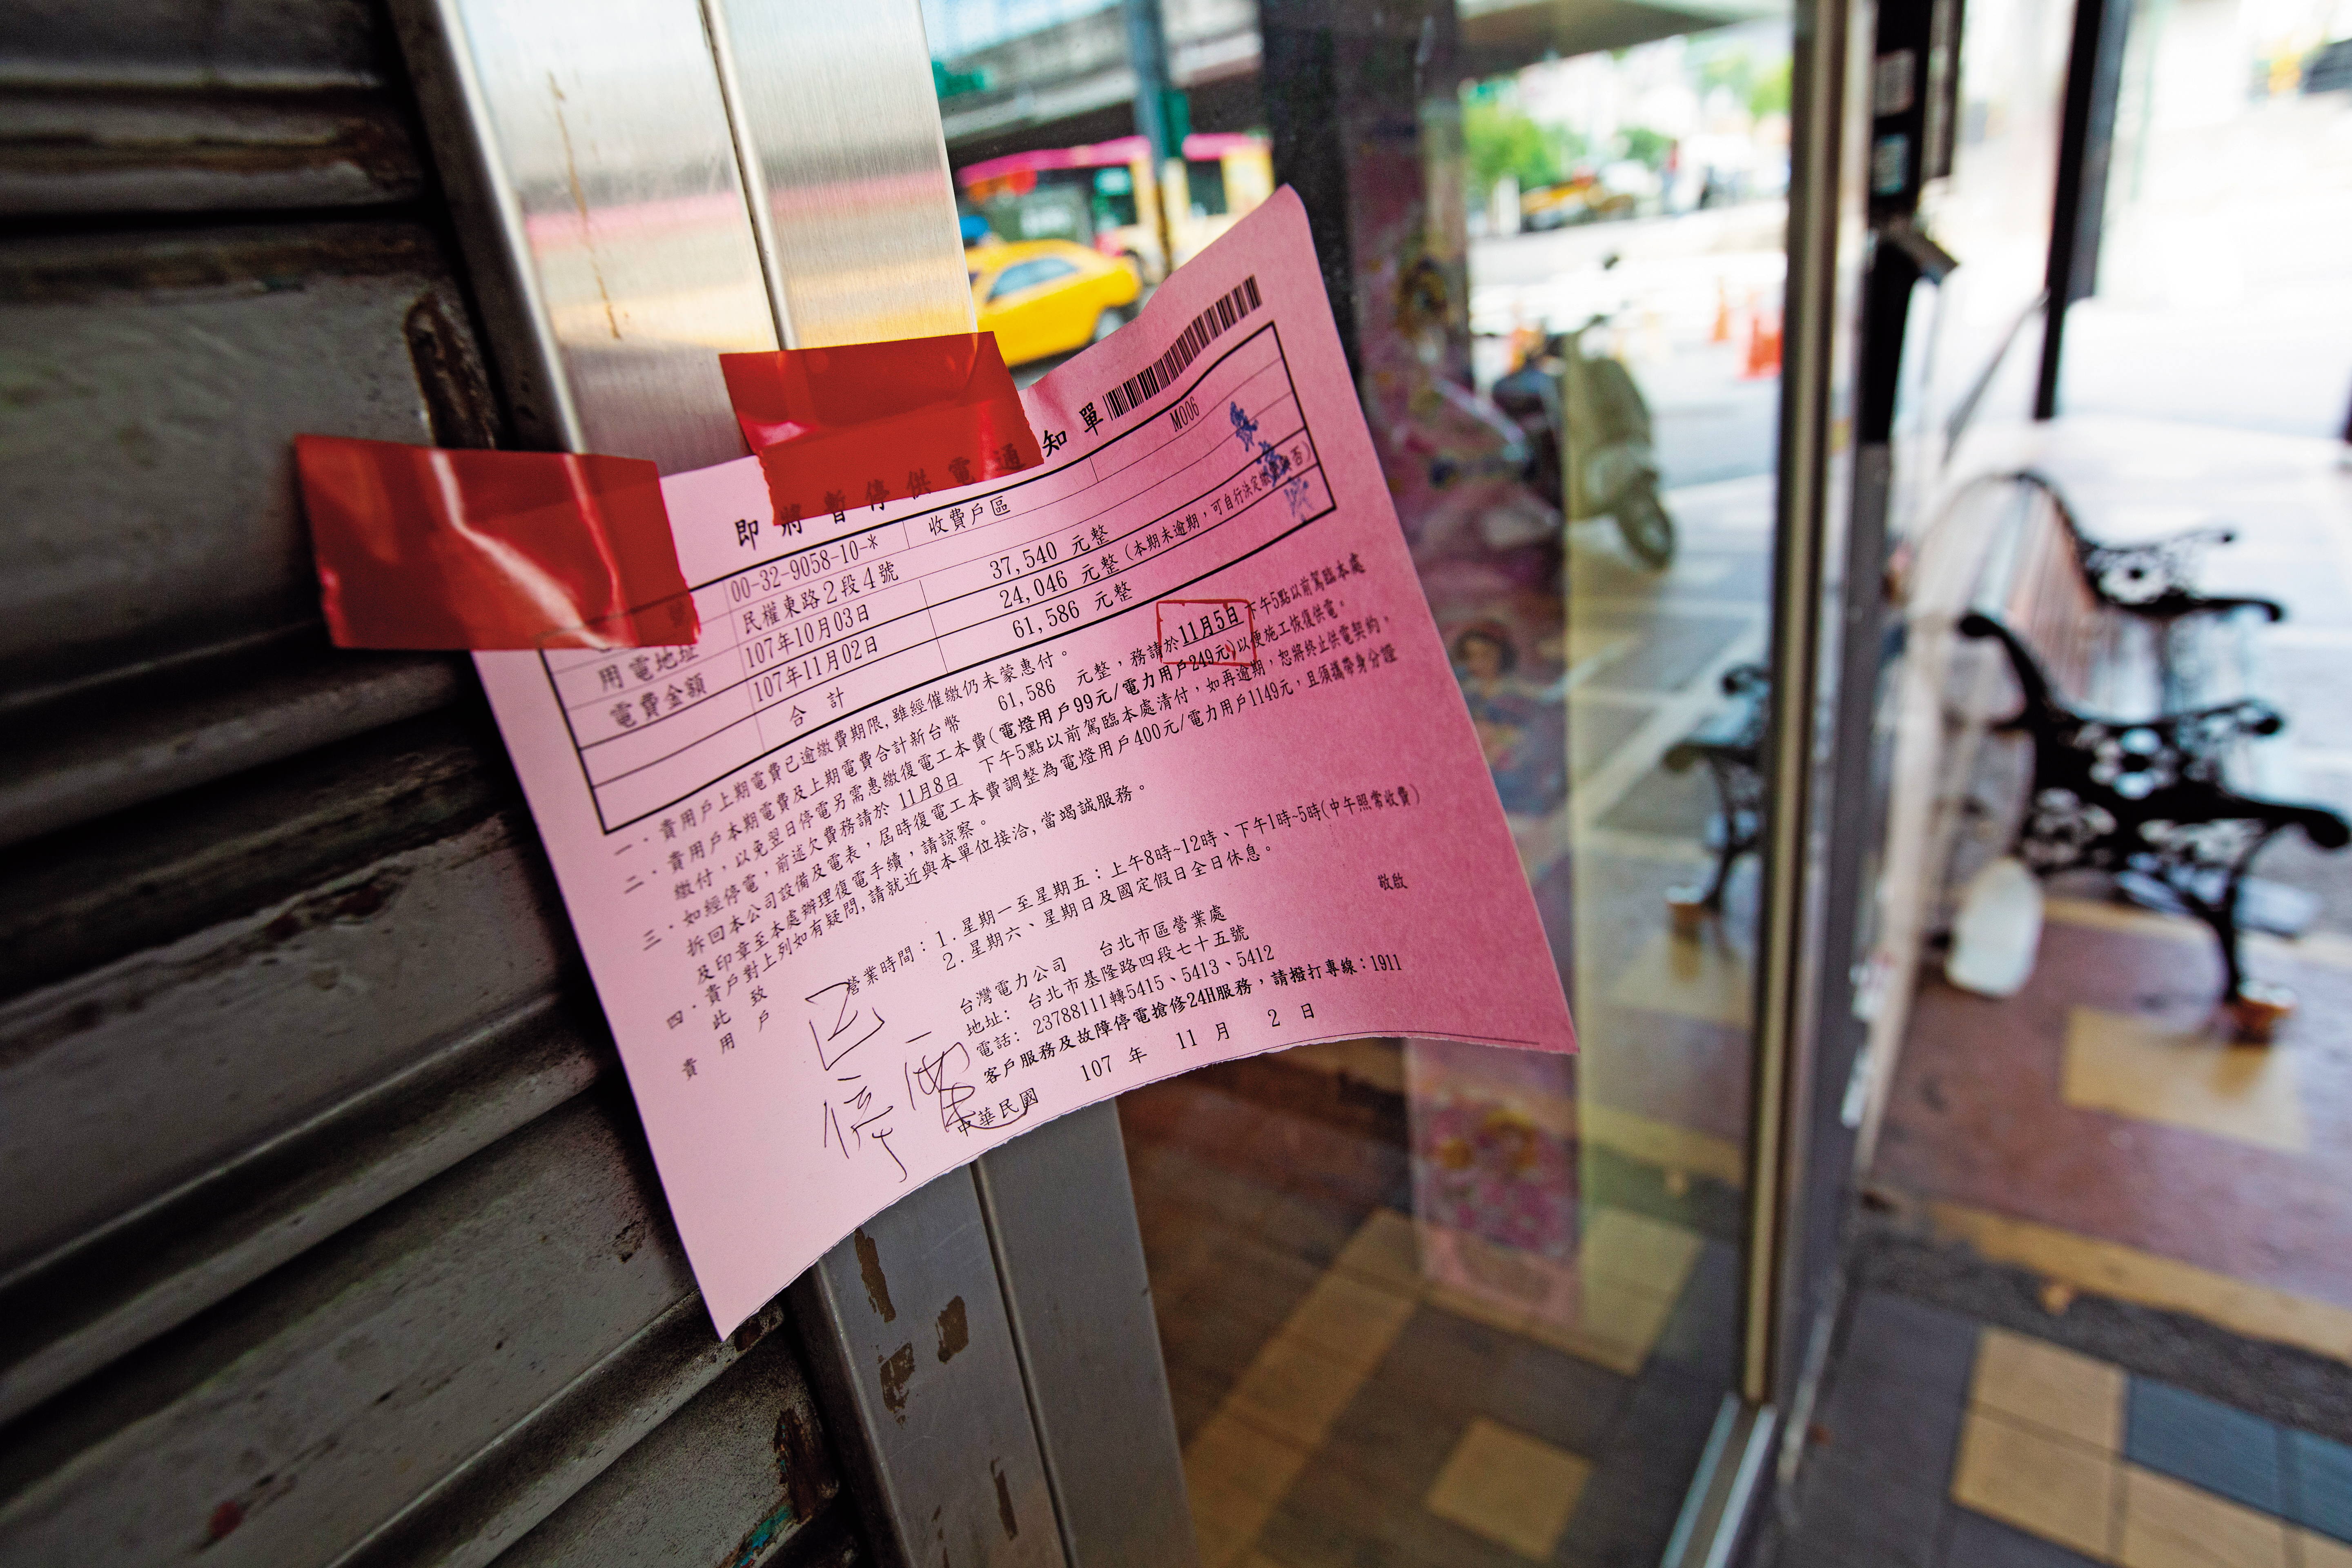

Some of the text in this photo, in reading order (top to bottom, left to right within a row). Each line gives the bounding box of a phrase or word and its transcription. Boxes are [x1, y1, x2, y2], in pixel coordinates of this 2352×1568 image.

[1171, 396, 1200, 433] M006
[928, 495, 1011, 537] 收費戶區
[990, 541, 1057, 579] 37,540
[743, 561, 899, 634] 民權東路2段4號
[1000, 571, 1067, 609] 24,046
[744, 605, 869, 668] 107年10月03日
[1013, 600, 1080, 639] 61,586
[753, 637, 878, 702] 107年11月02日
[609, 672, 707, 728] 電費金額
[998, 678, 1055, 711] 61,586
[960, 956, 1066, 1015] 台灣電力公司
[1099, 904, 1227, 957] 台北市區營業處
[1029, 924, 1249, 1009] 台北市基隆路四段七十五號
[1080, 1055, 1113, 1082] 107
